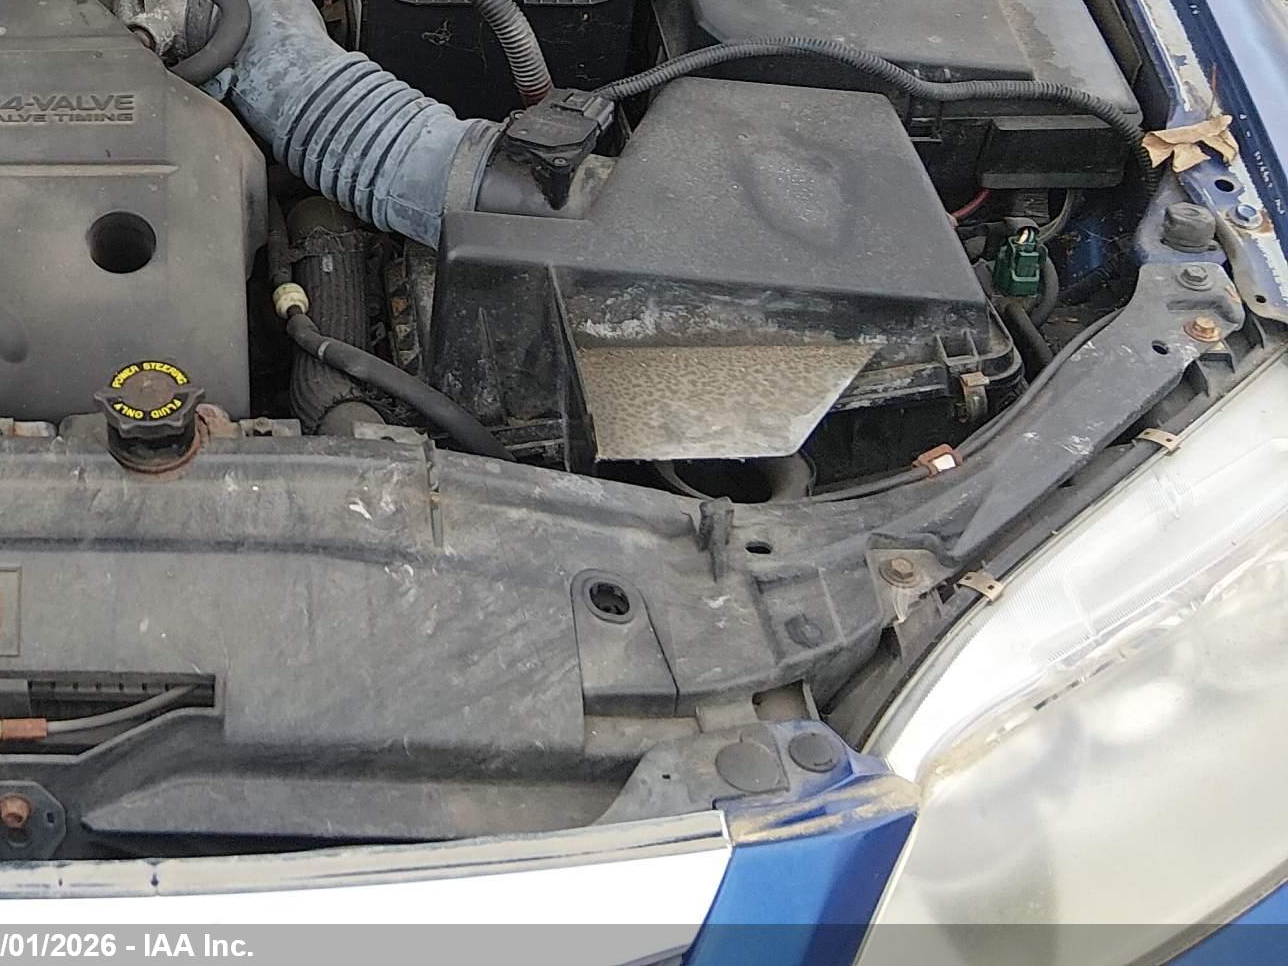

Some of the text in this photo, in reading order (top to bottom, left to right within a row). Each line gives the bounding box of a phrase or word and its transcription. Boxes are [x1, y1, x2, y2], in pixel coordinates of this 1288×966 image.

[52, 113, 134, 122] TIMING
[112, 362, 189, 389] POWER STEERING
[113, 398, 183, 419] FLUID ONLY
